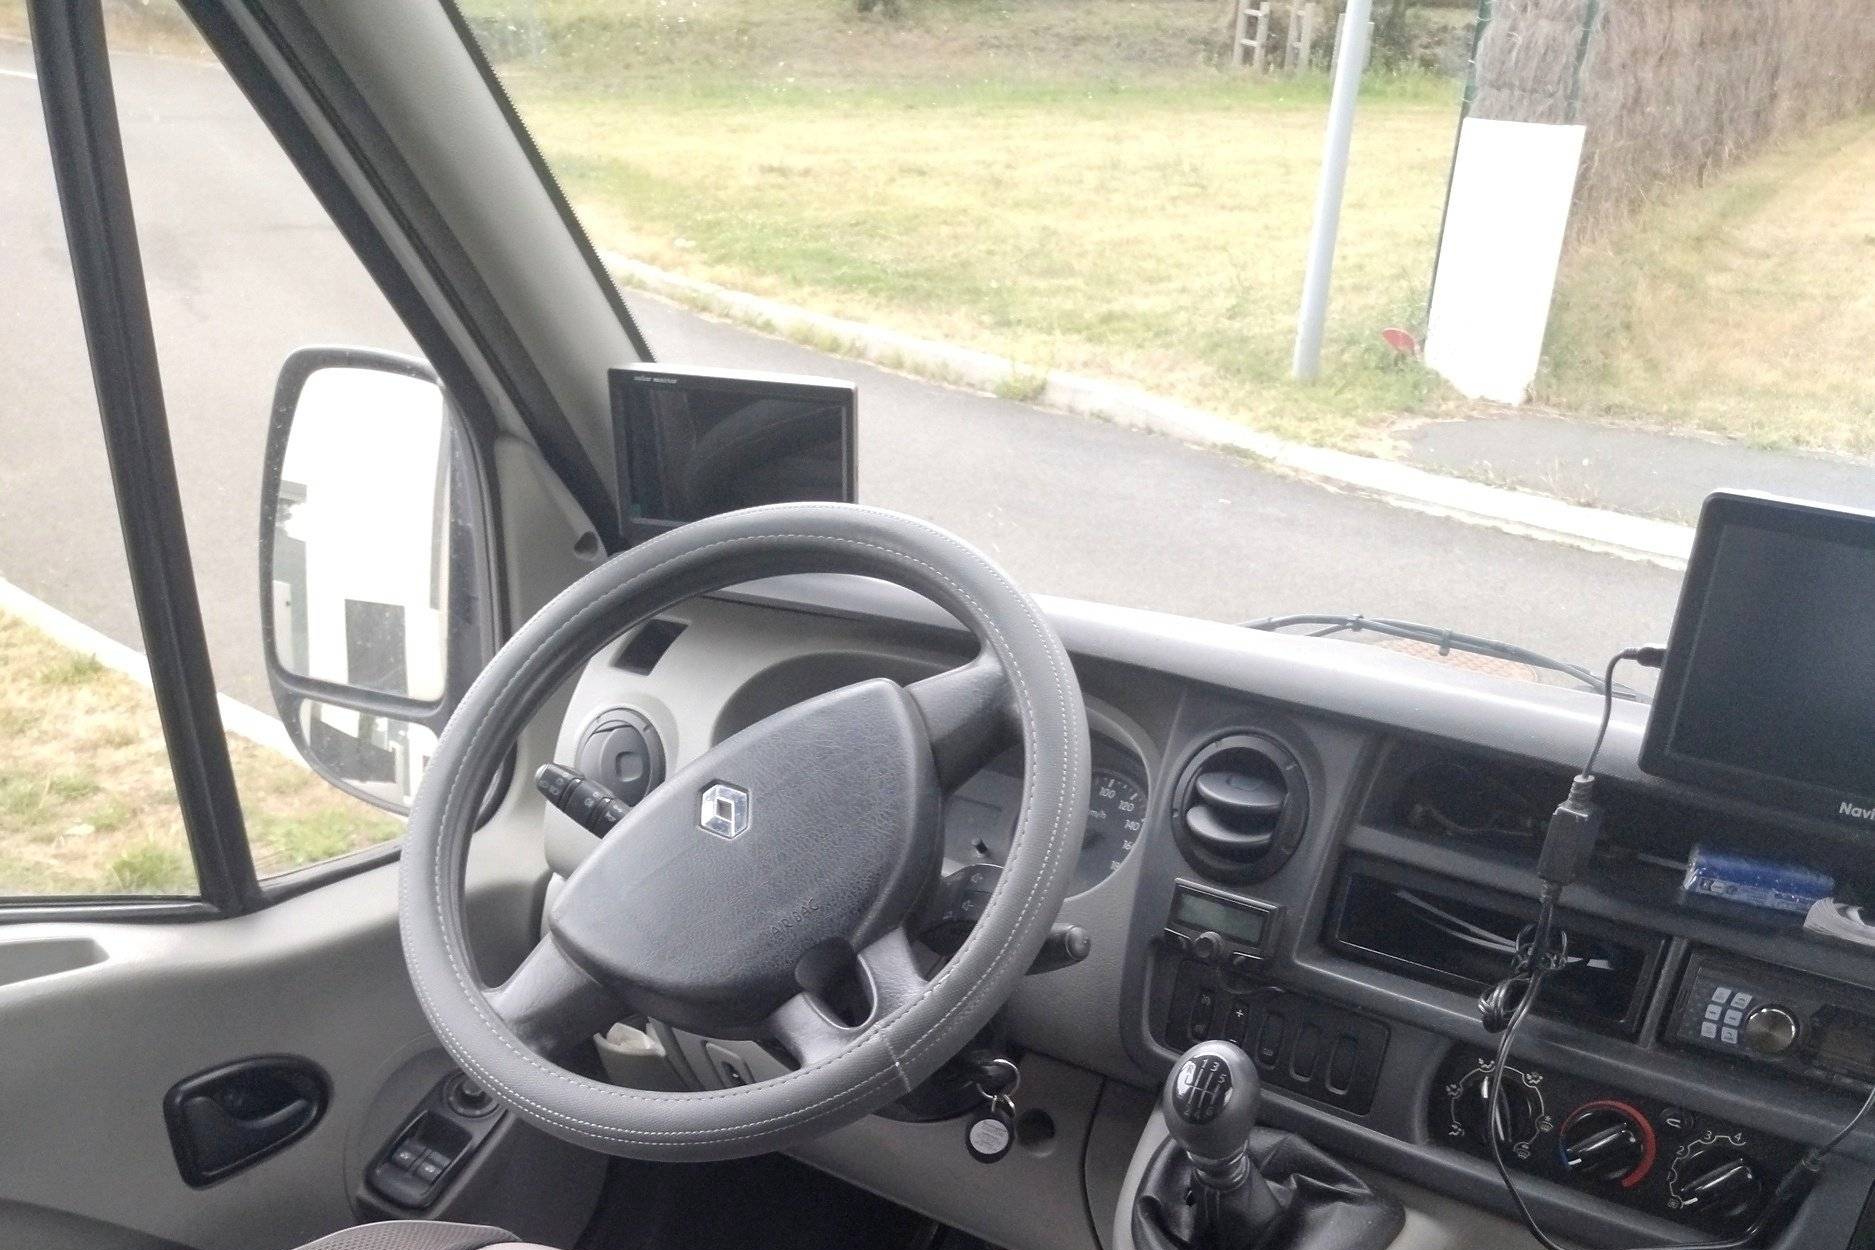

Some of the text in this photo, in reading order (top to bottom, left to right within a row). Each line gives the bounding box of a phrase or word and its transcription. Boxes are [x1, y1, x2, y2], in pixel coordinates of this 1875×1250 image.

[1099, 786, 1117, 799] 100
[1118, 799, 1135, 812] 120
[1124, 819, 1142, 831] 140
[1210, 1061, 1220, 1072] 3
[1217, 1073, 1228, 1084] 5
[1704, 1130, 1713, 1140] 3
[1734, 1132, 1743, 1142] 4
[1676, 1145, 1685, 1155] 2
